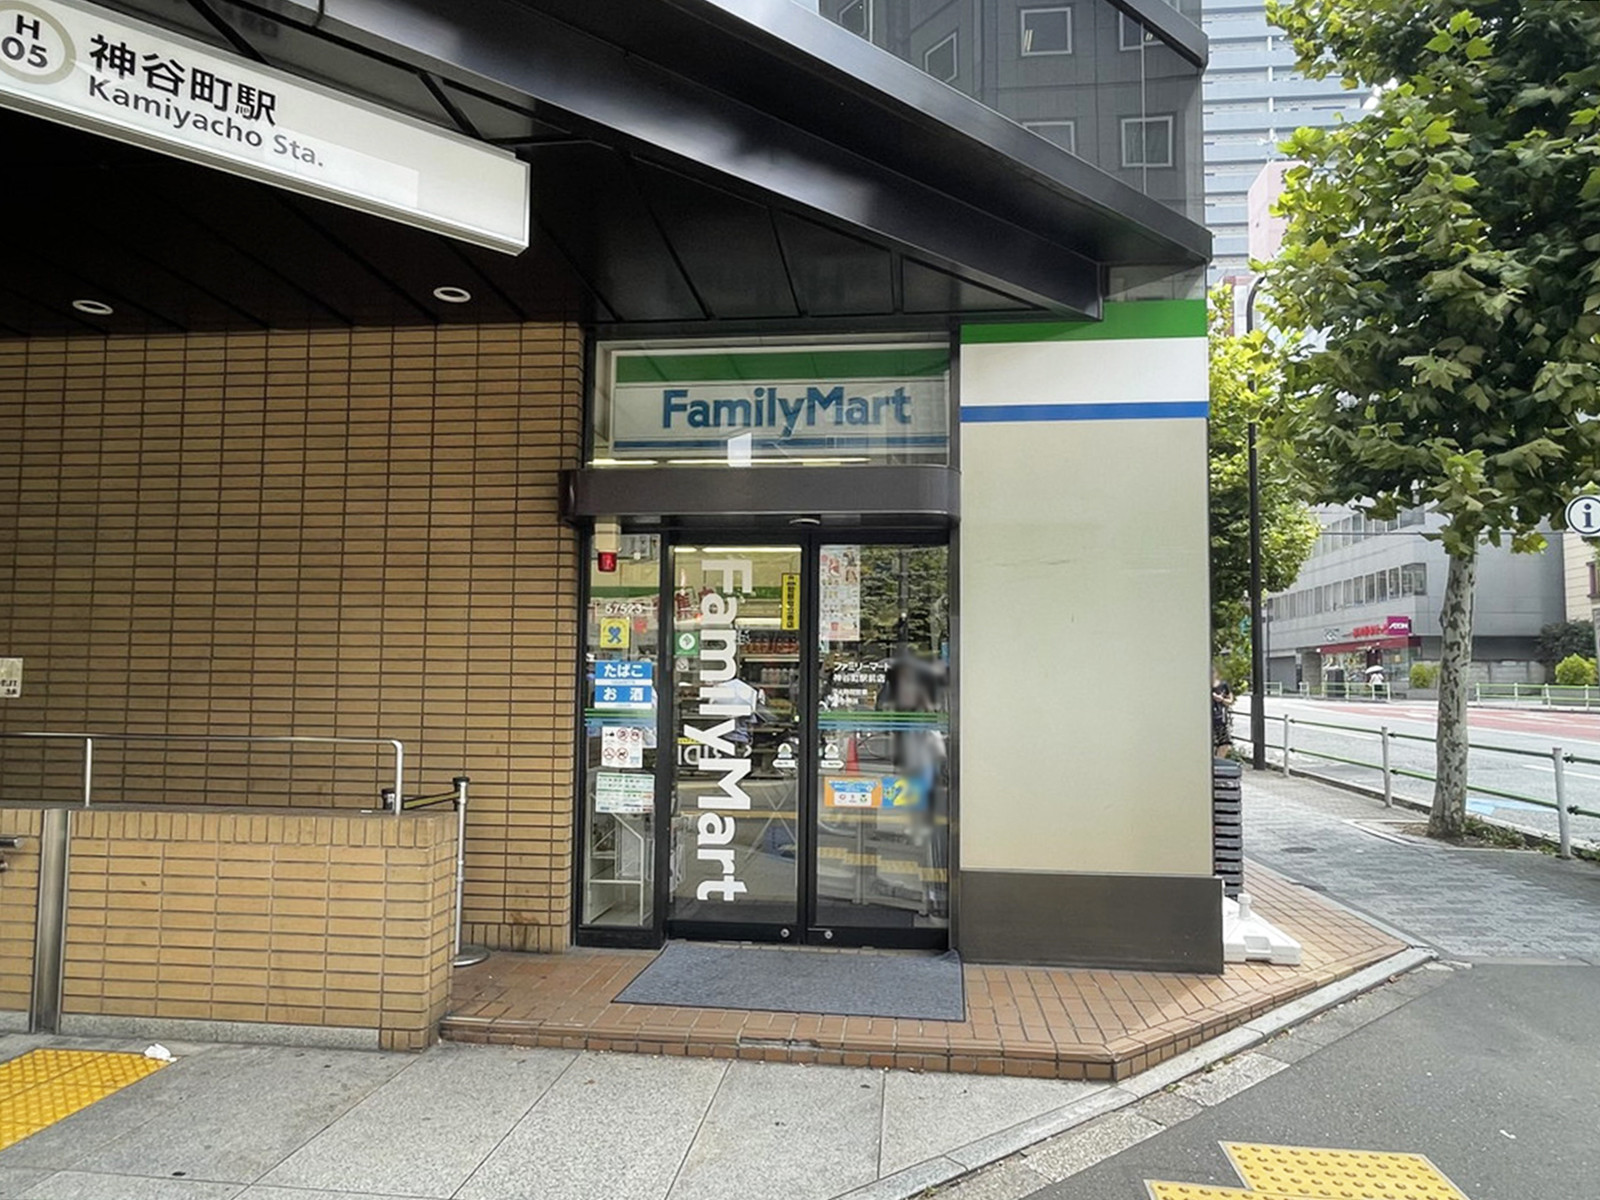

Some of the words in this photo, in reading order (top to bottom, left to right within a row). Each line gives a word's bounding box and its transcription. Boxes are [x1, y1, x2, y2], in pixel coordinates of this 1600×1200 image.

[16, 14, 40, 40] H
[2, 36, 48, 68] 05
[89, 34, 276, 126] 神谷町駅
[89, 75, 263, 147] Kamiyacho
[273, 134, 324, 167] Sta.
[662, 386, 912, 437] FamilyMart
[603, 663, 644, 677] たばこ
[833, 661, 889, 672] ファミリーマート
[683, 560, 752, 901] FamilyMart
